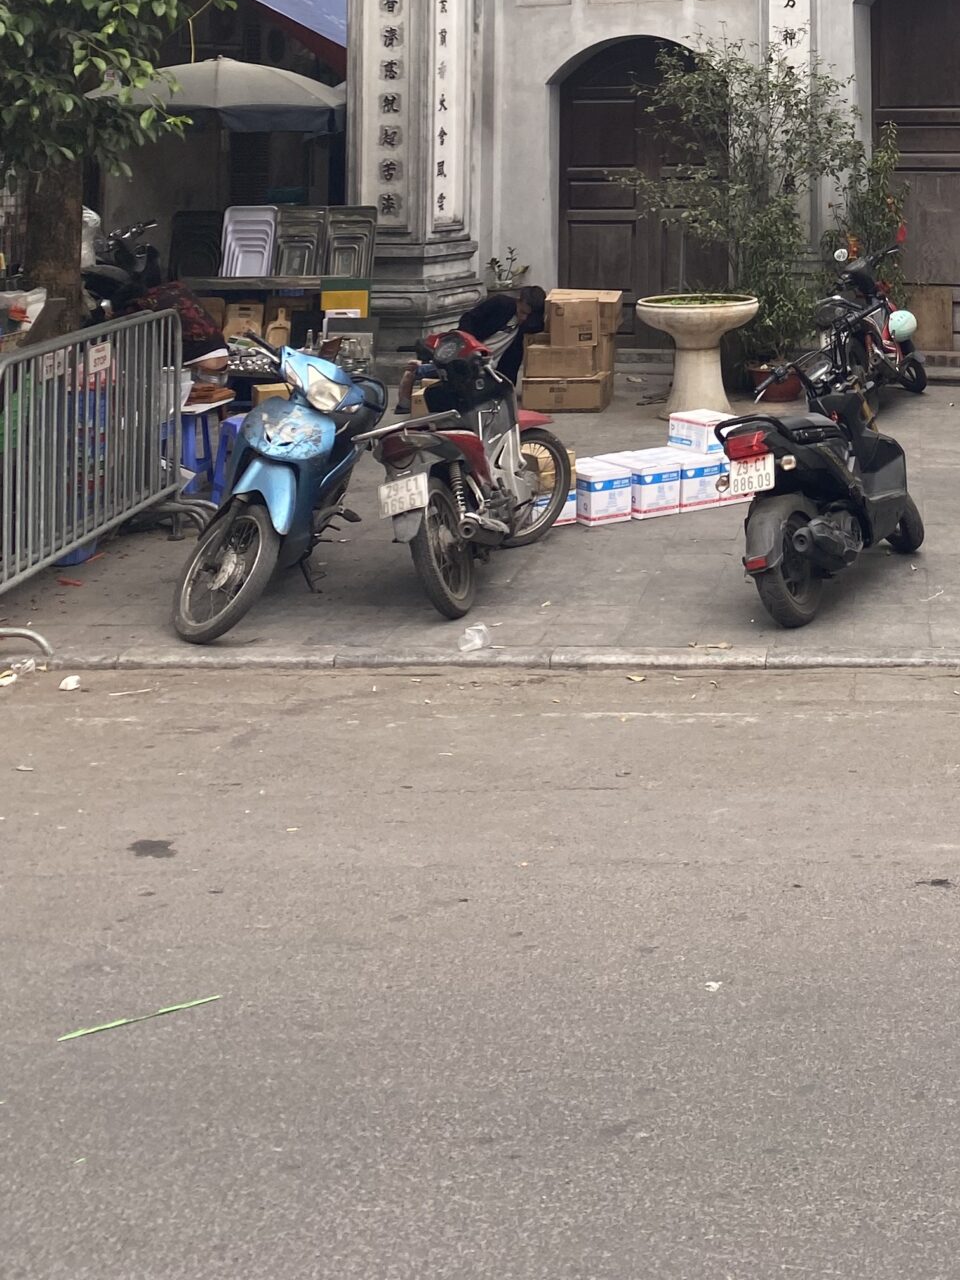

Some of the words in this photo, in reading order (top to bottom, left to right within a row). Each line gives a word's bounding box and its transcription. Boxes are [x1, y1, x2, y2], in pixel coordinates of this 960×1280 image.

[737, 456, 766, 476] 29-C1
[386, 477, 418, 499] 29-C1
[733, 472, 771, 492] 886.09
